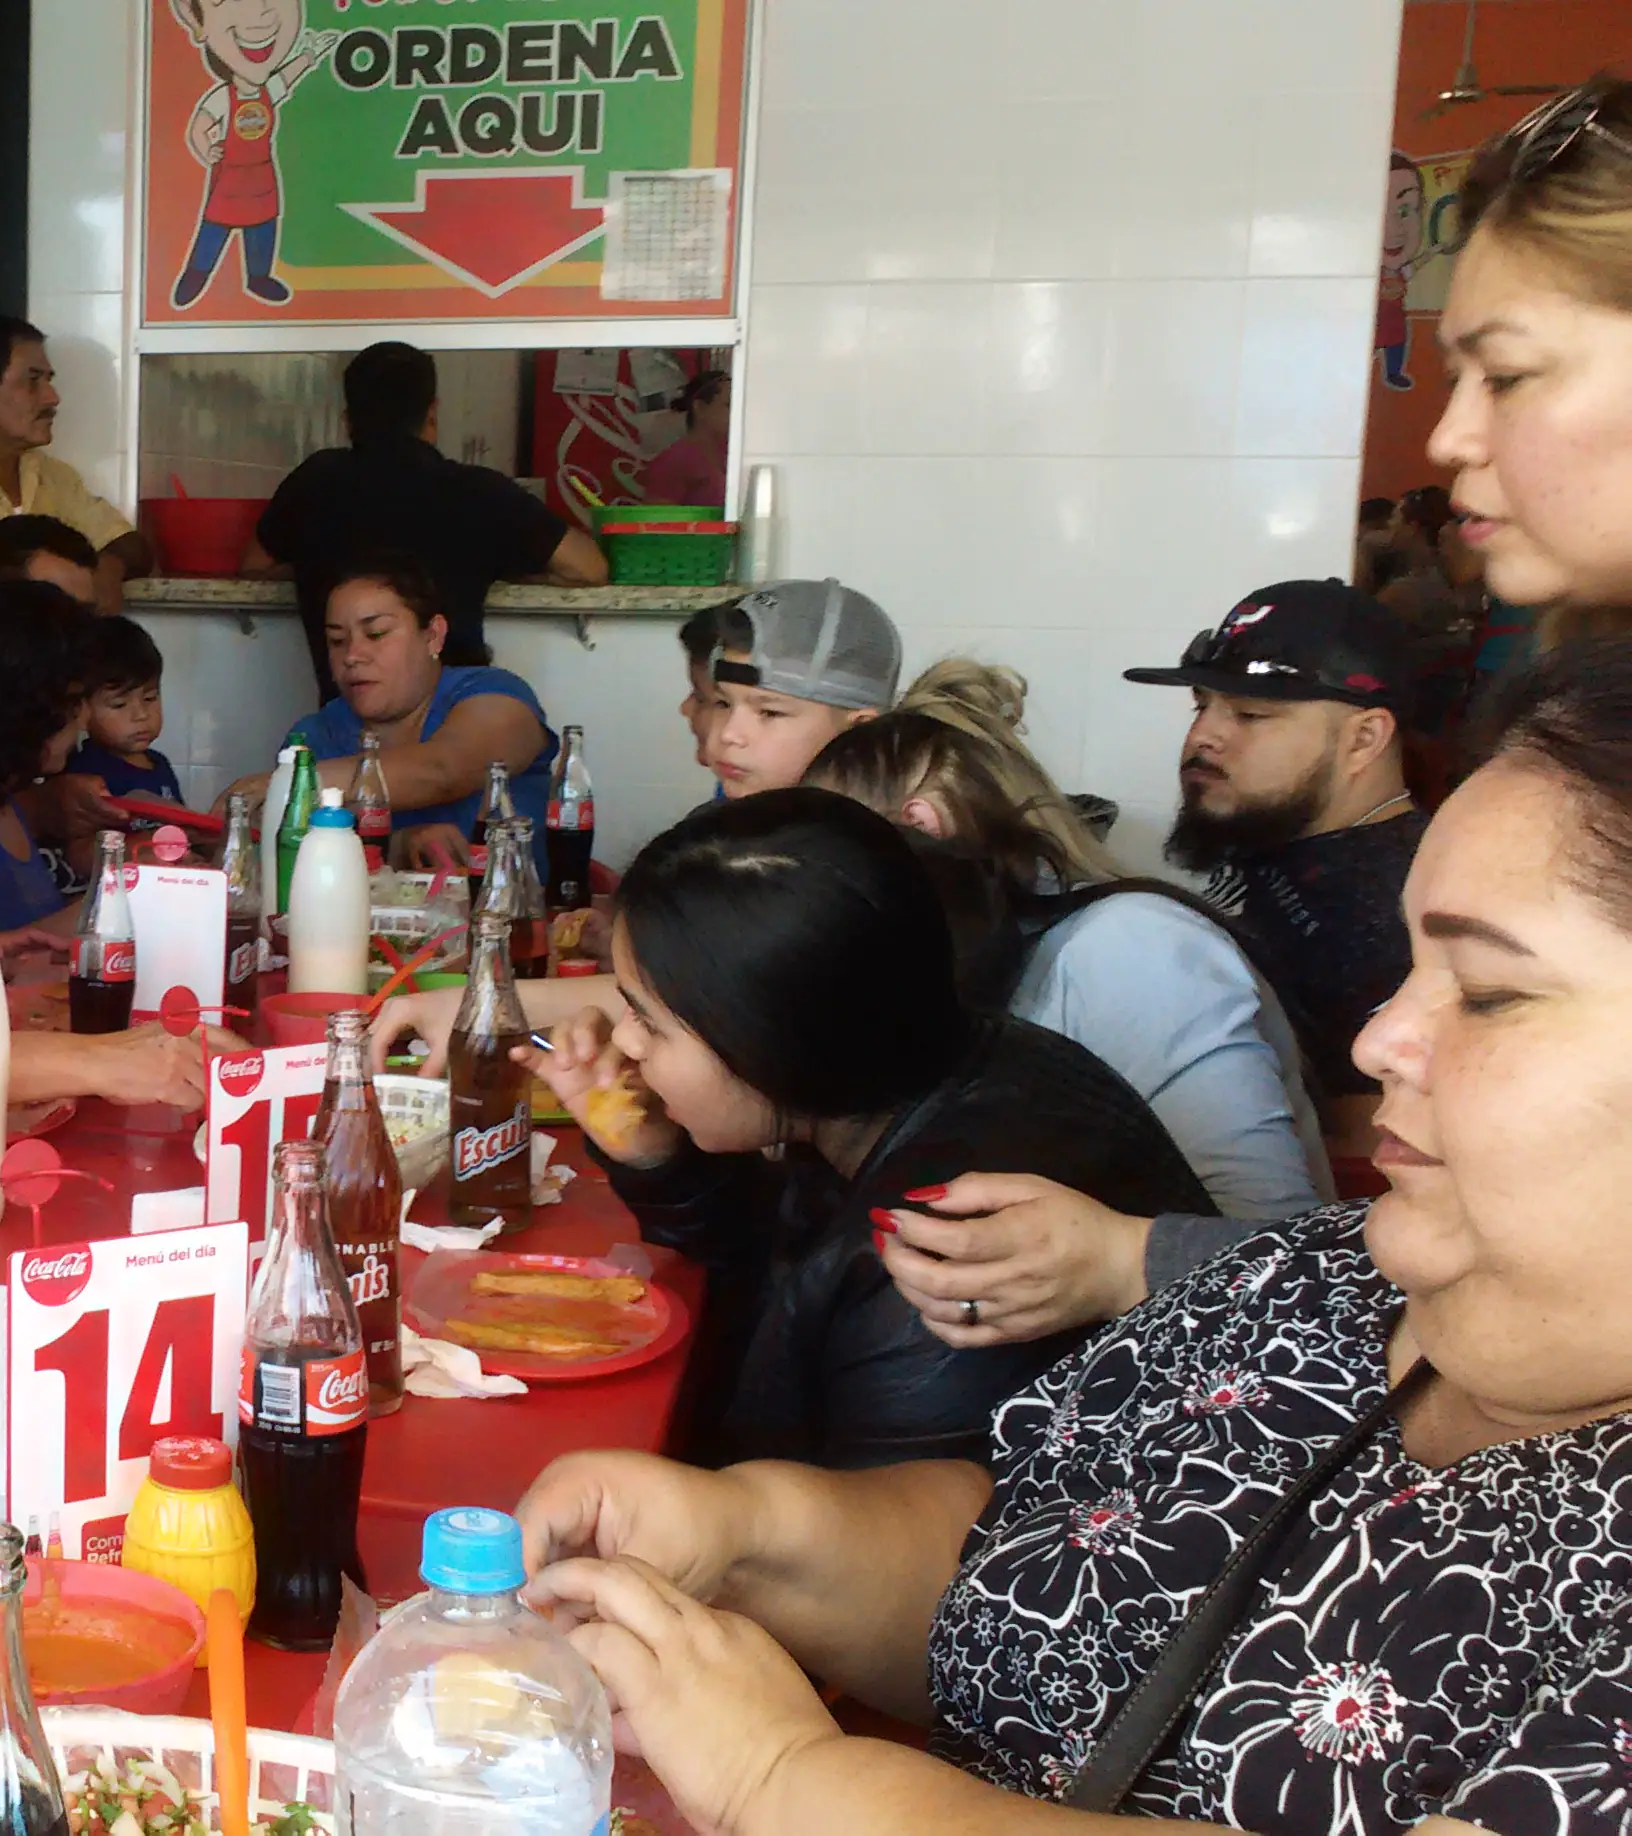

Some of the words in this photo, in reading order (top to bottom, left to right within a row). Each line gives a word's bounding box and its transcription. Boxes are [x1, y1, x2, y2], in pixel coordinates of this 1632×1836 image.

[333, 17, 681, 91] ORDENA
[396, 91, 603, 157] AQUI
[125, 1250, 165, 1268] Menú
[168, 1246, 190, 1262] del
[194, 1244, 217, 1259] día
[33, 1292, 225, 1505] 14
